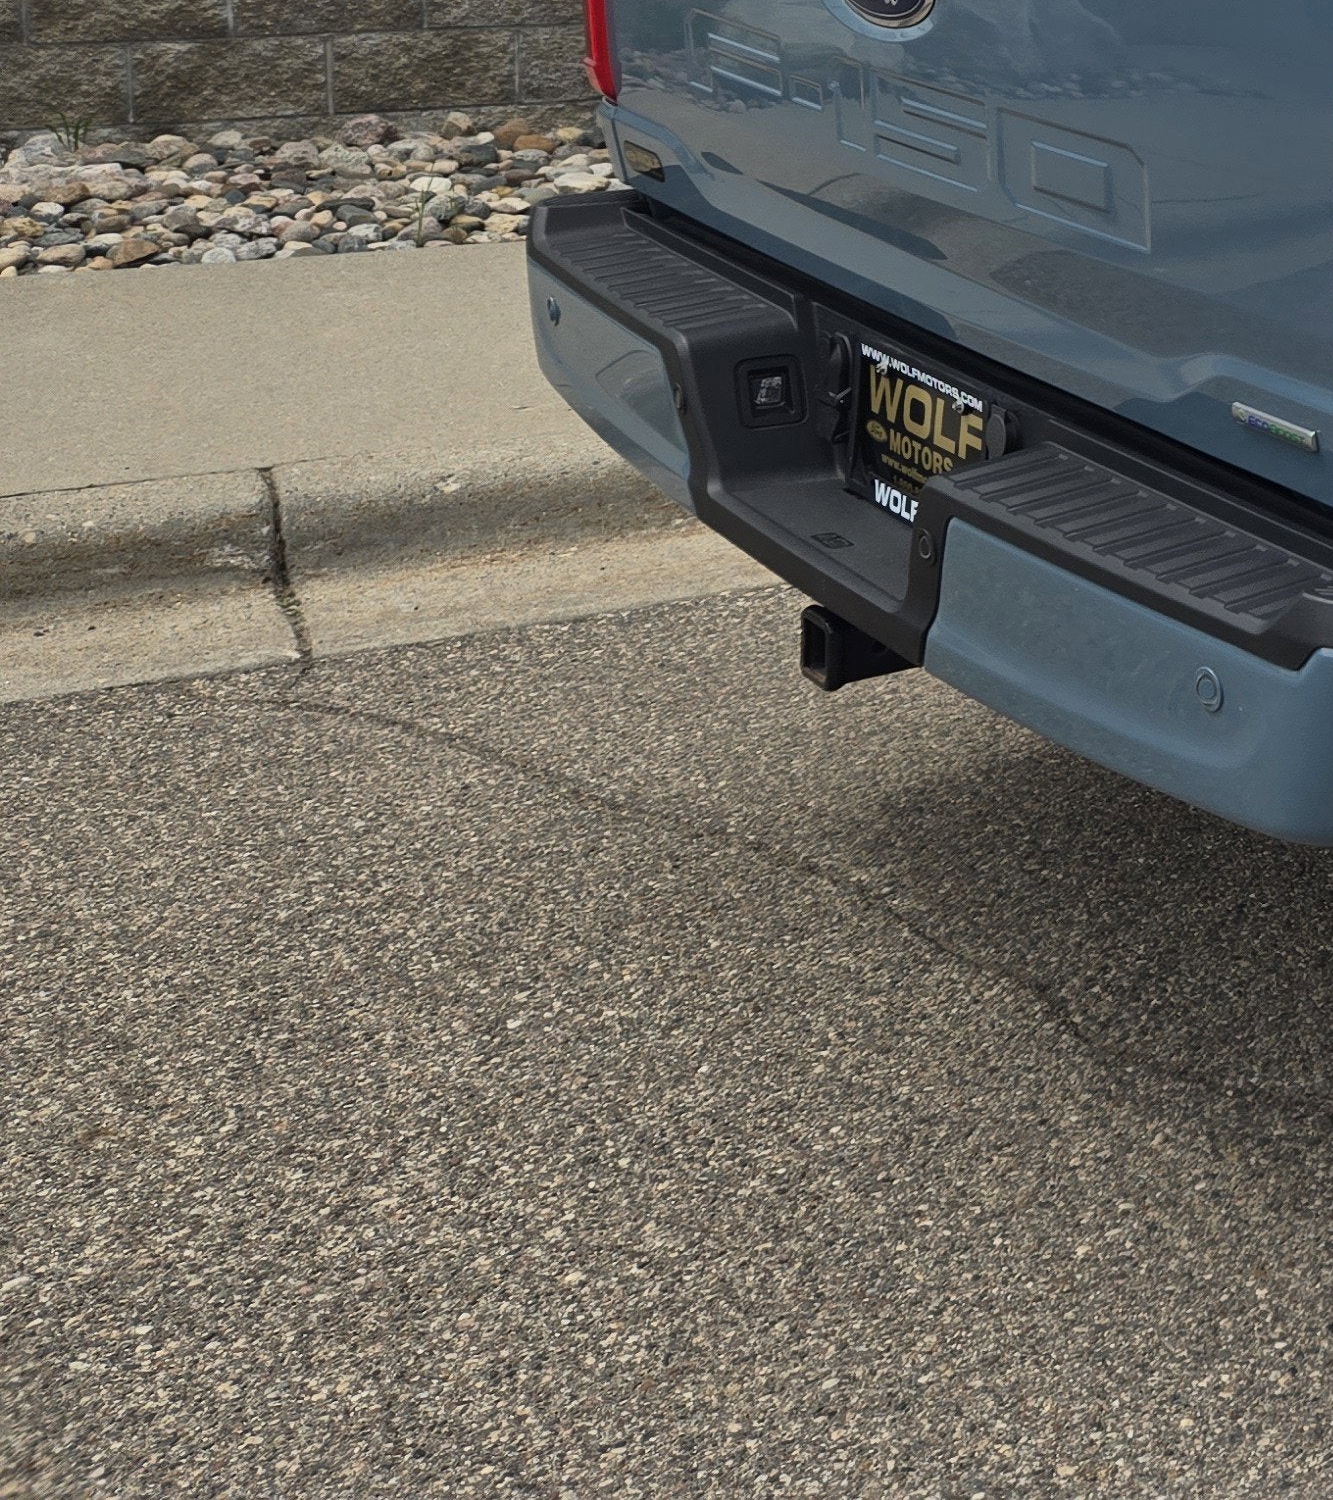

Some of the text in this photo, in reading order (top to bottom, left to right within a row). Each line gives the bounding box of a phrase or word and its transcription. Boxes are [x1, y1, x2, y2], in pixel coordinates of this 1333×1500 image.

[686, 7, 1153, 253] F-150
[860, 342, 983, 412] WWW.WOLFMOTORS.COM
[869, 364, 983, 459] WOLF
[889, 427, 954, 474] MOTORS
[874, 479, 919, 523] WOLF
